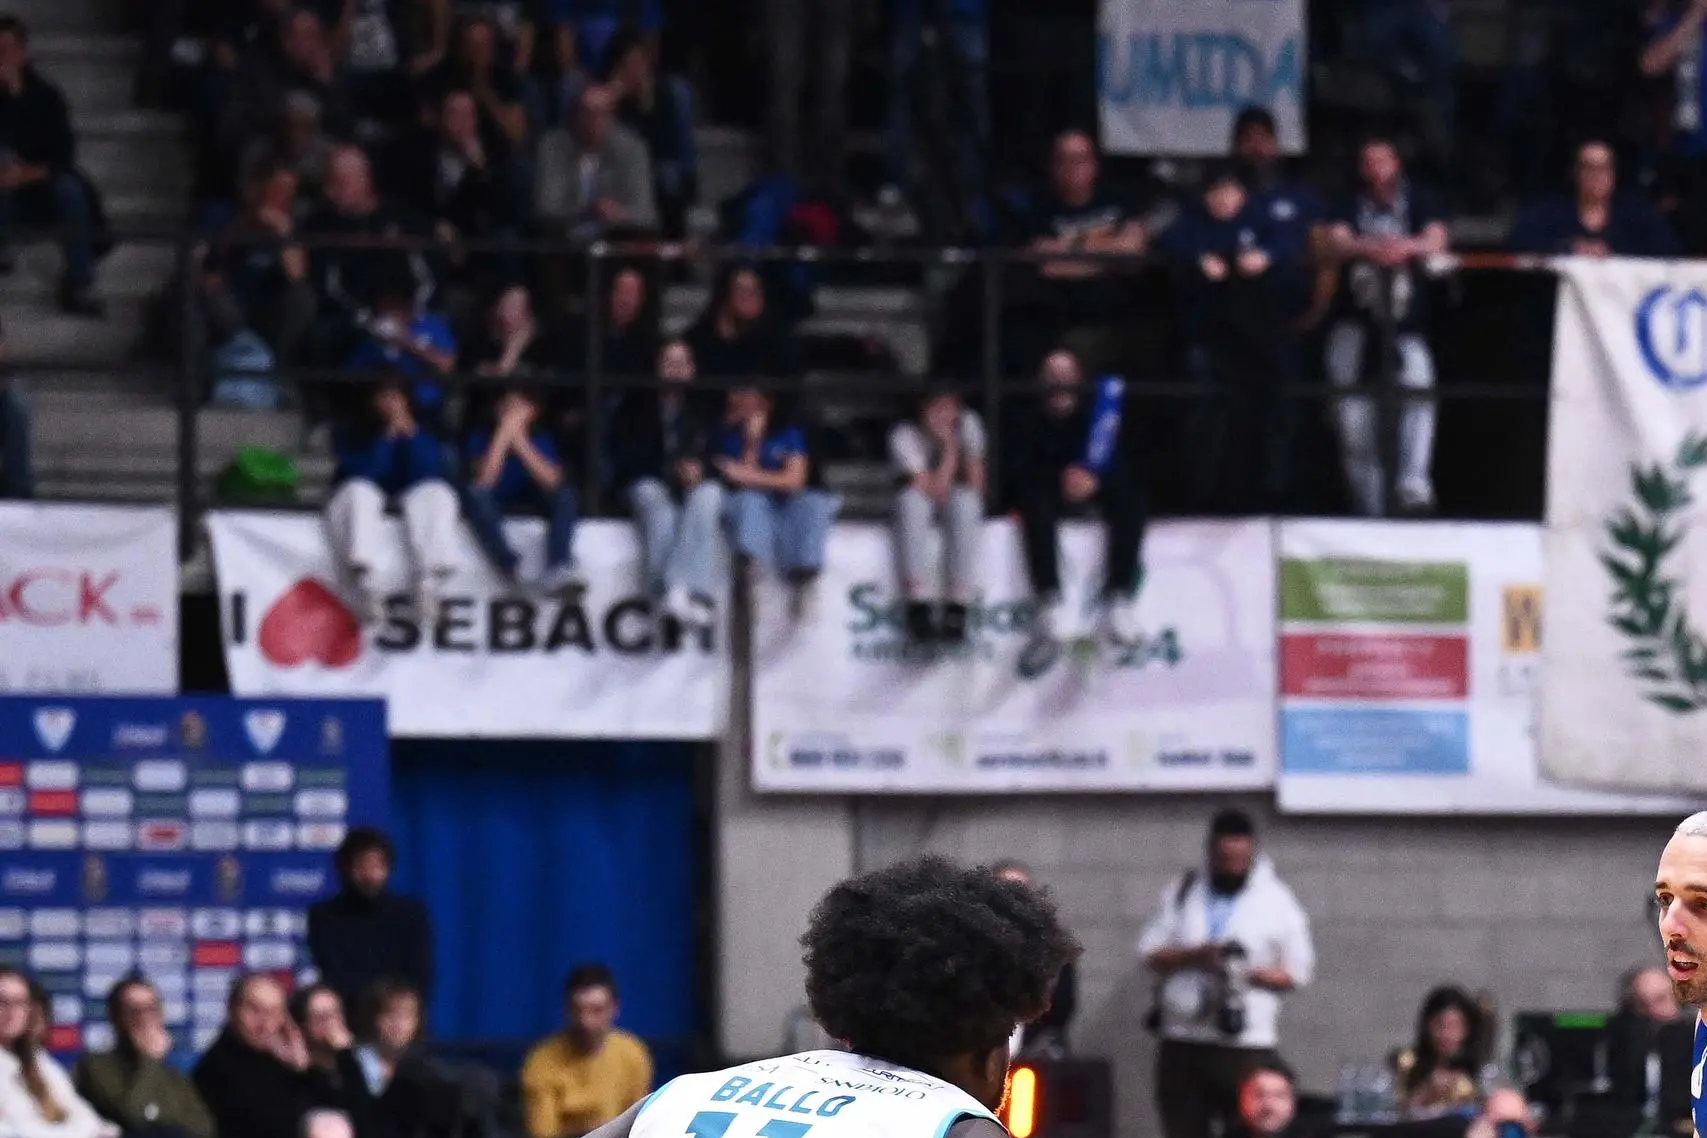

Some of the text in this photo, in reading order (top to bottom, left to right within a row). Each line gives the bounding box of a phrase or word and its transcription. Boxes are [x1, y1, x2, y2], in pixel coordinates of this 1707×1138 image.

[0, 565, 121, 628] CK
[232, 590, 246, 645] I
[710, 1075, 857, 1118] BALLO
